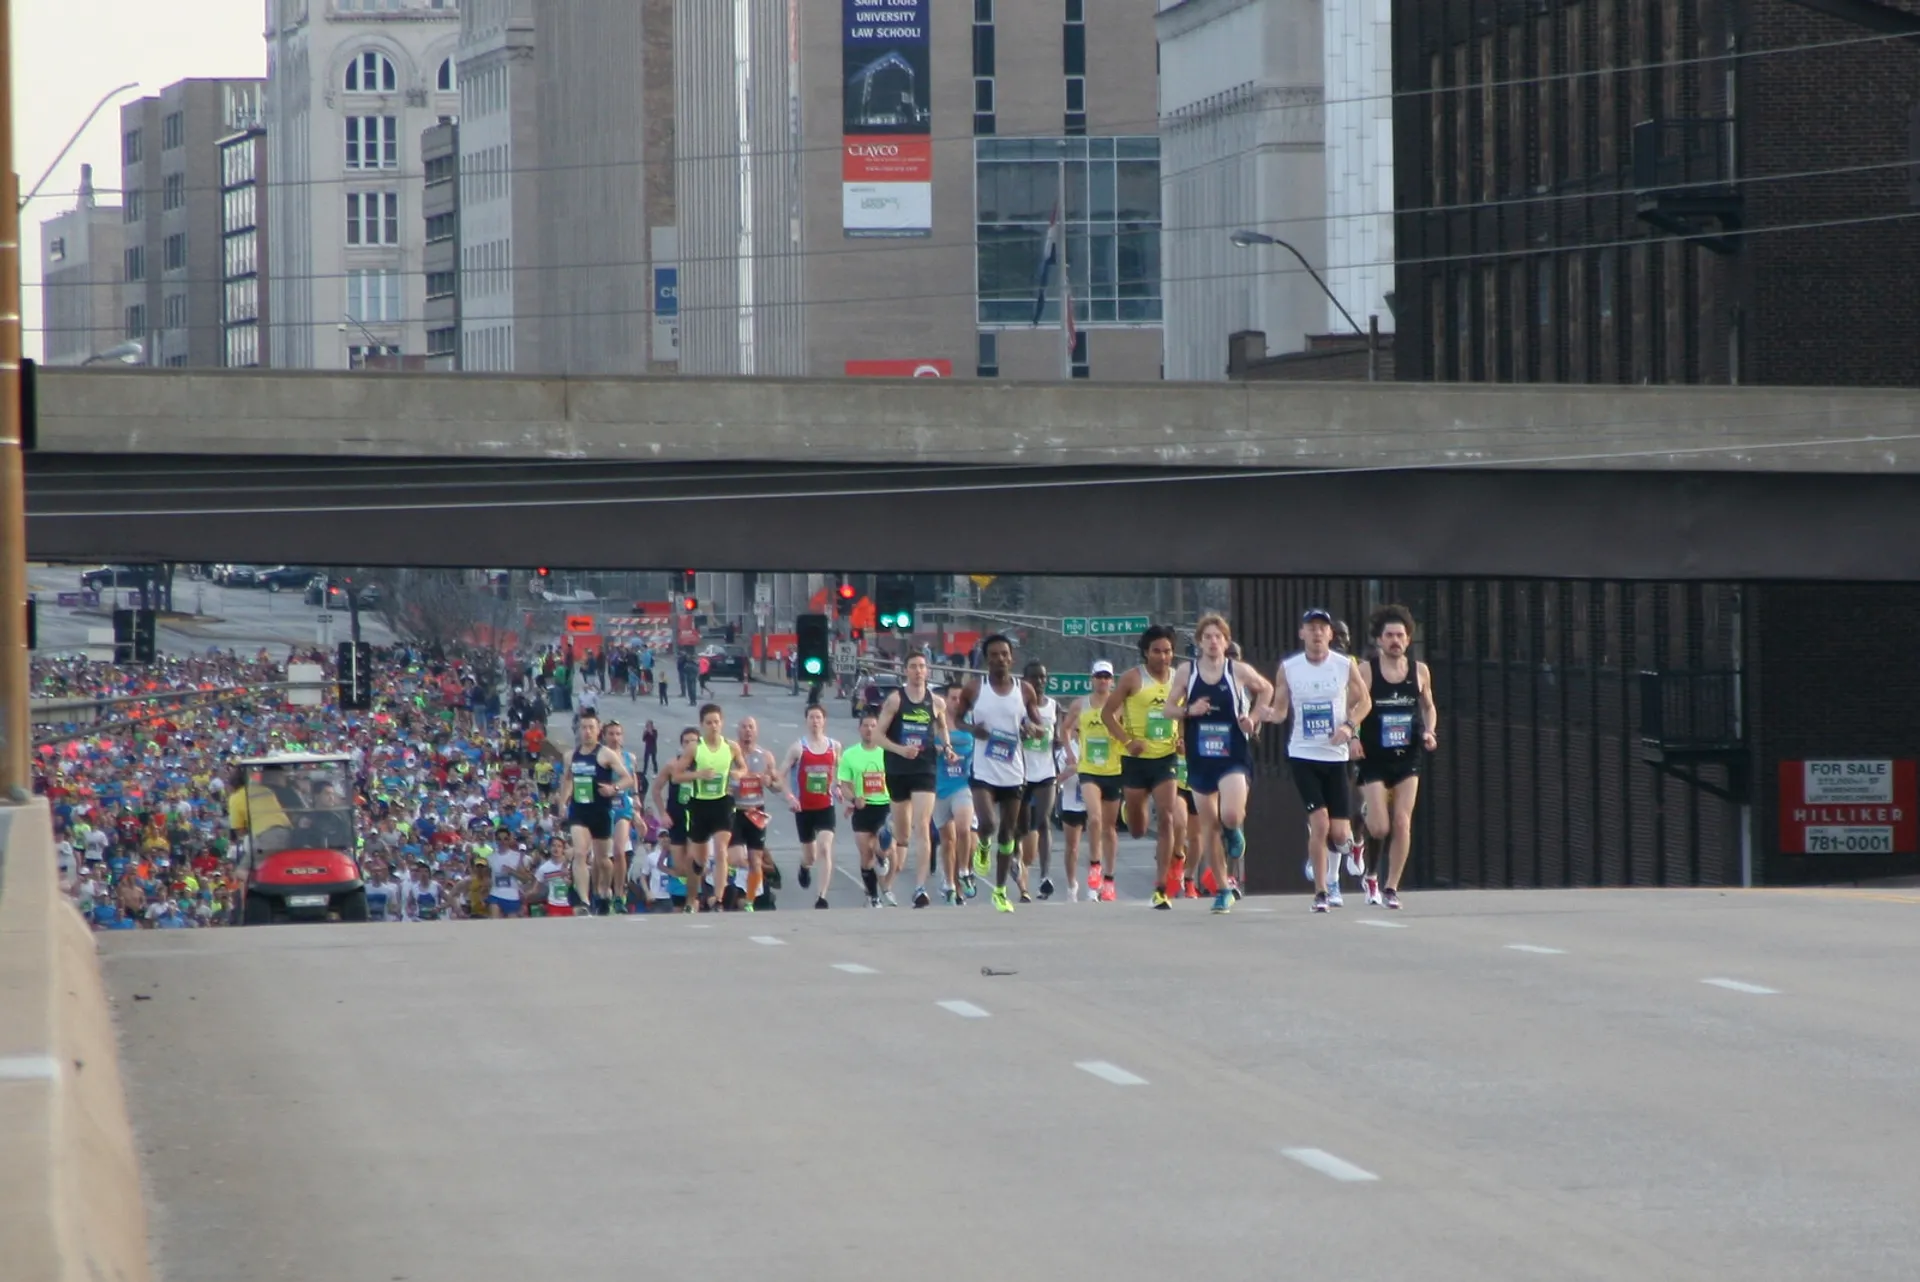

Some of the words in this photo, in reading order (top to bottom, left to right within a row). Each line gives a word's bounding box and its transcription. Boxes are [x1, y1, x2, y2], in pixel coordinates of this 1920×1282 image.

[856, 11, 916, 22] UNIVERSITY
[851, 27, 874, 38] LAW
[876, 27, 921, 38] SCHOOL!
[848, 144, 899, 157] CLAYCO
[1090, 621, 1132, 632] Clark
[1810, 763, 1842, 775] FOR
[1846, 763, 1886, 775] SALE
[1794, 808, 1903, 821] HILLIKER
[1809, 836, 1890, 851] 781-0001
